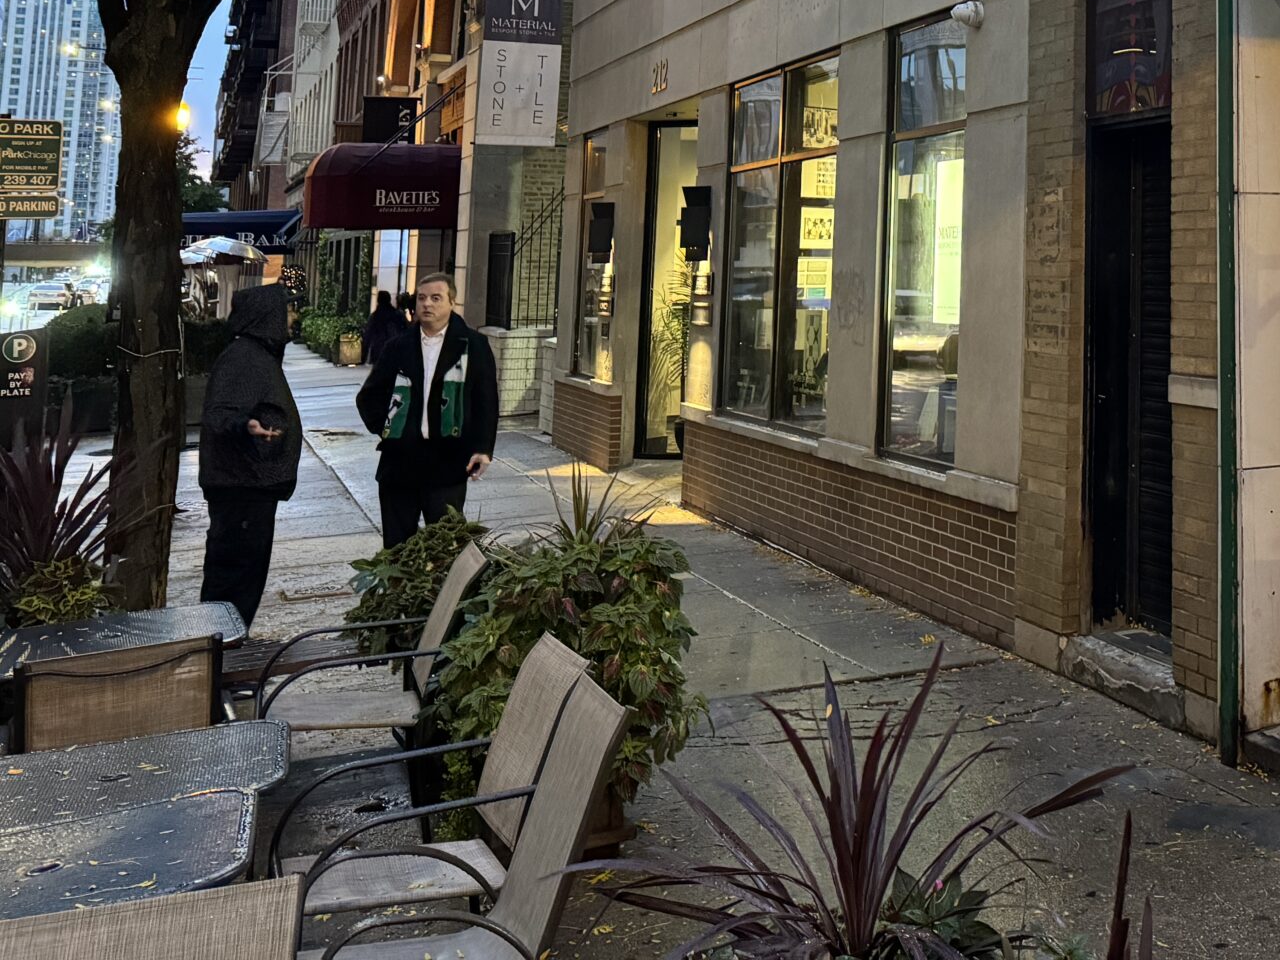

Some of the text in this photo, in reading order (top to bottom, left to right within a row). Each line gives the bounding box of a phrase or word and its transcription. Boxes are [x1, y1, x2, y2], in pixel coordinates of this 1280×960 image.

[491, 17, 556, 31] MATERIAL
[651, 58, 669, 95] 212
[14, 123, 54, 134] PARK
[1, 150, 57, 161] ParkChicago
[3, 175, 53, 185] 239 407
[9, 201, 56, 212] PARKING
[12, 338, 28, 358] P
[7, 372, 26, 380] PAY
[0, 388, 31, 396] PLATE
